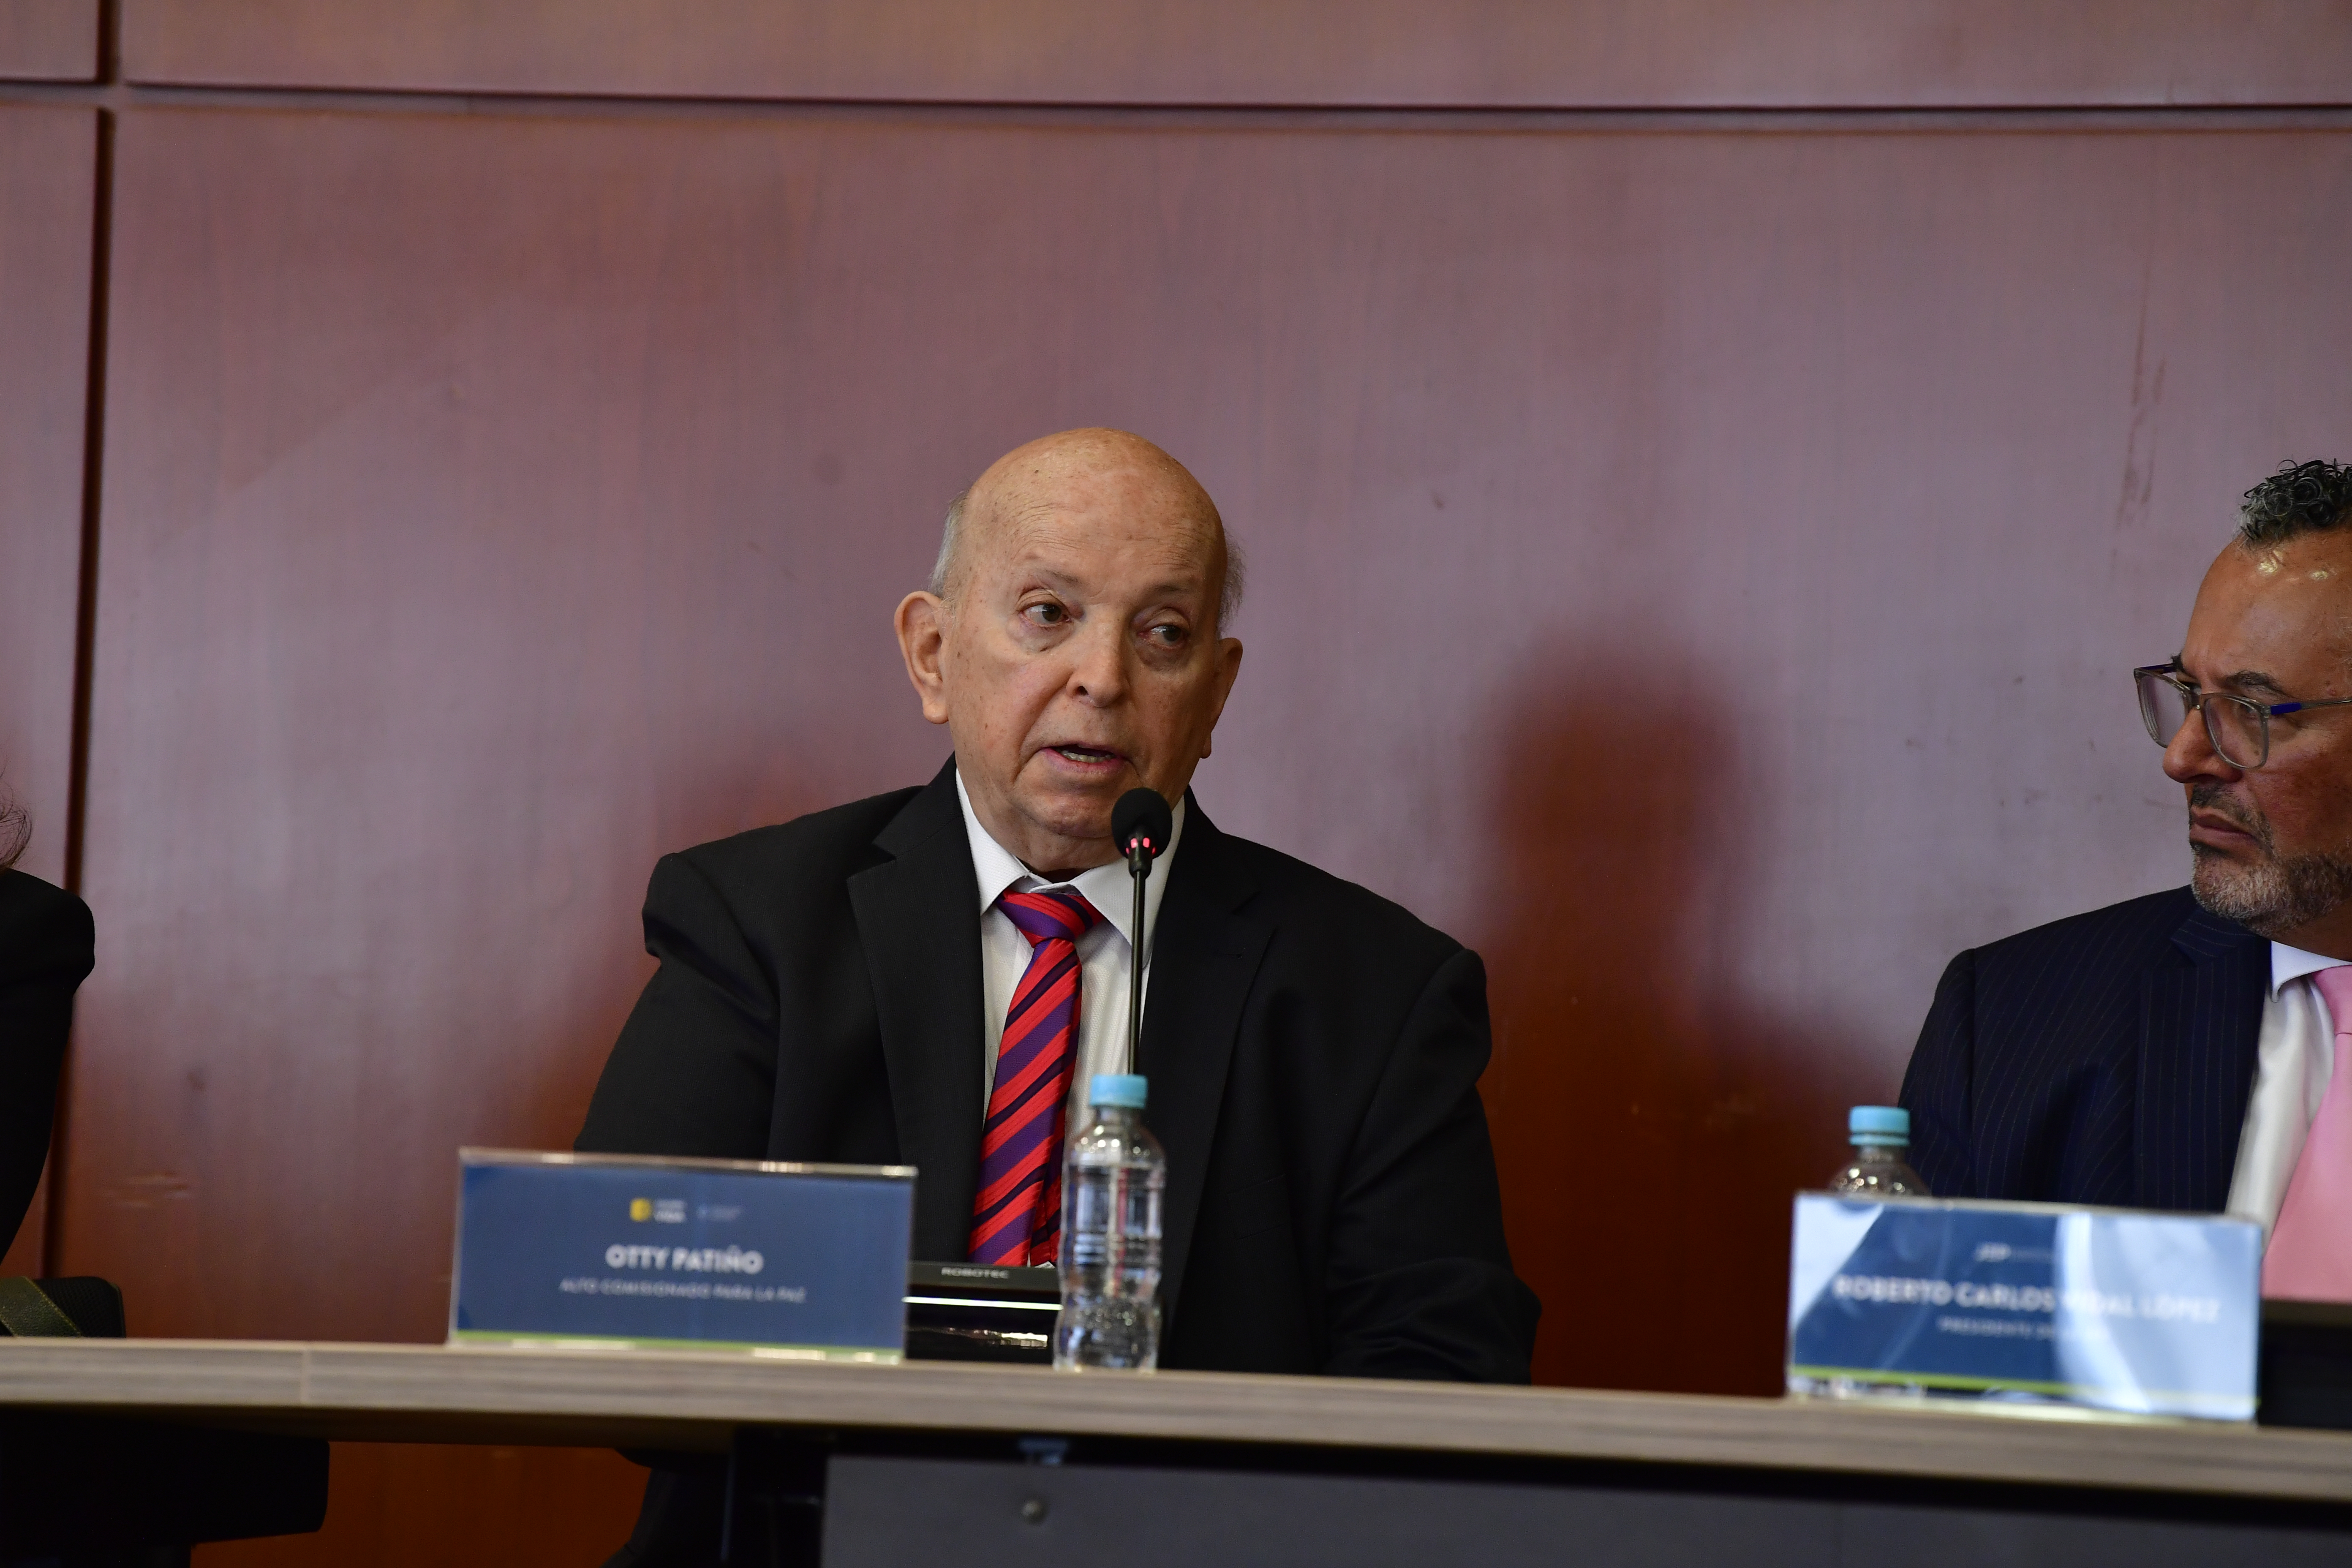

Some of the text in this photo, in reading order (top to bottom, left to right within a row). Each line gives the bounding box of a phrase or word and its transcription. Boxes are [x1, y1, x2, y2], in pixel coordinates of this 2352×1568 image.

[605, 1244, 764, 1274] OTTY PATIÑO
[942, 1268, 1009, 1279] ROBOTEC
[559, 1277, 807, 1304] ALTO COMISIONADO PARA LA PAZ
[1833, 1275, 1953, 1306] ROBERTO
[1954, 1282, 2055, 1312] CARLOS
